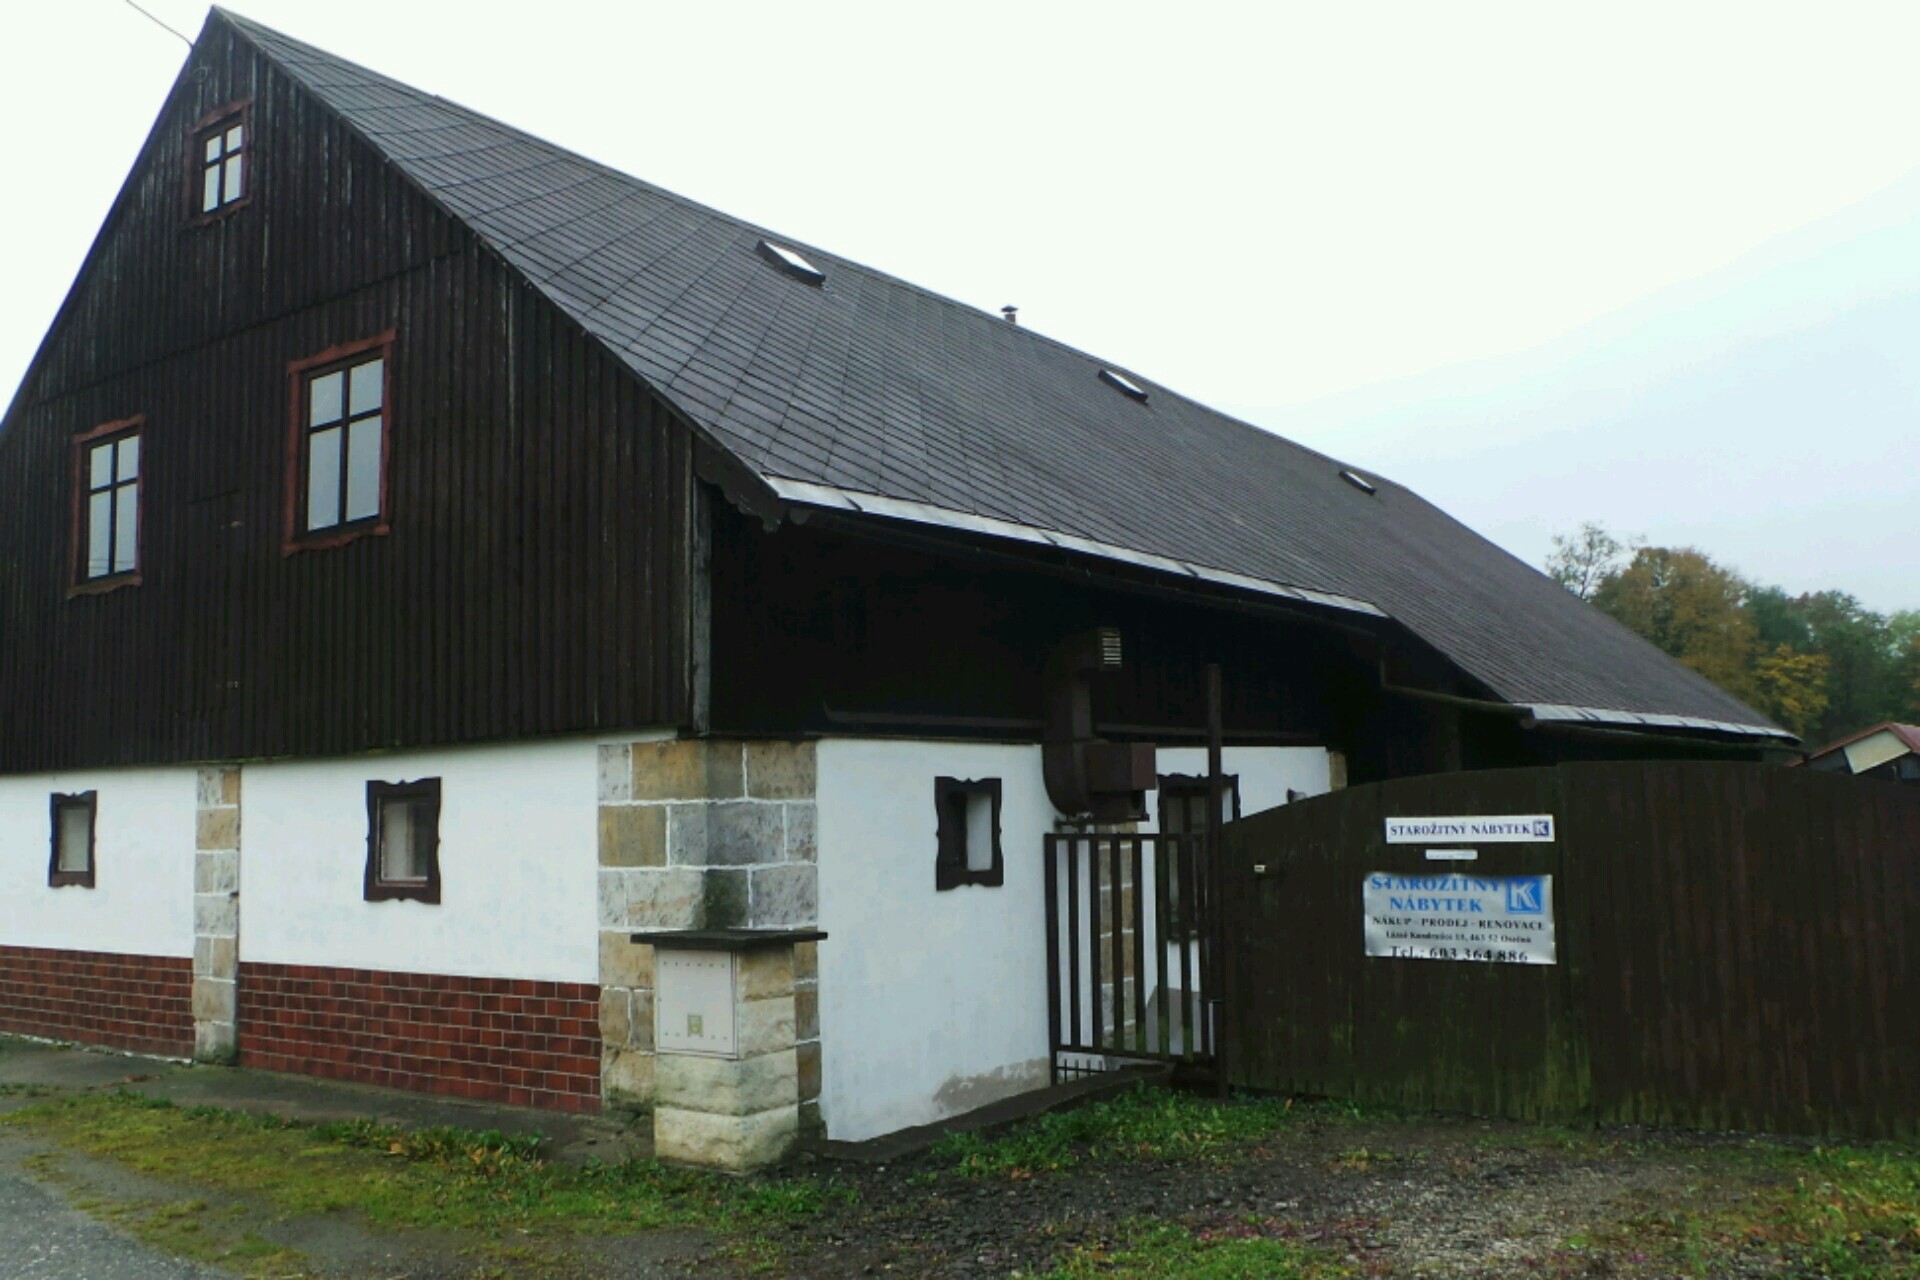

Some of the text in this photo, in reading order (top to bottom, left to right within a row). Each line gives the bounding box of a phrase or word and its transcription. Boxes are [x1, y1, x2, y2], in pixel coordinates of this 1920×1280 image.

[1390, 822, 1466, 835] STAROŽITNÝ
[1471, 822, 1530, 835] NÁBYTEK
[1389, 894, 1482, 912] NÁBYTEK
[1421, 917, 1468, 928] PRODEJ
[1479, 919, 1544, 931] RENOVACE
